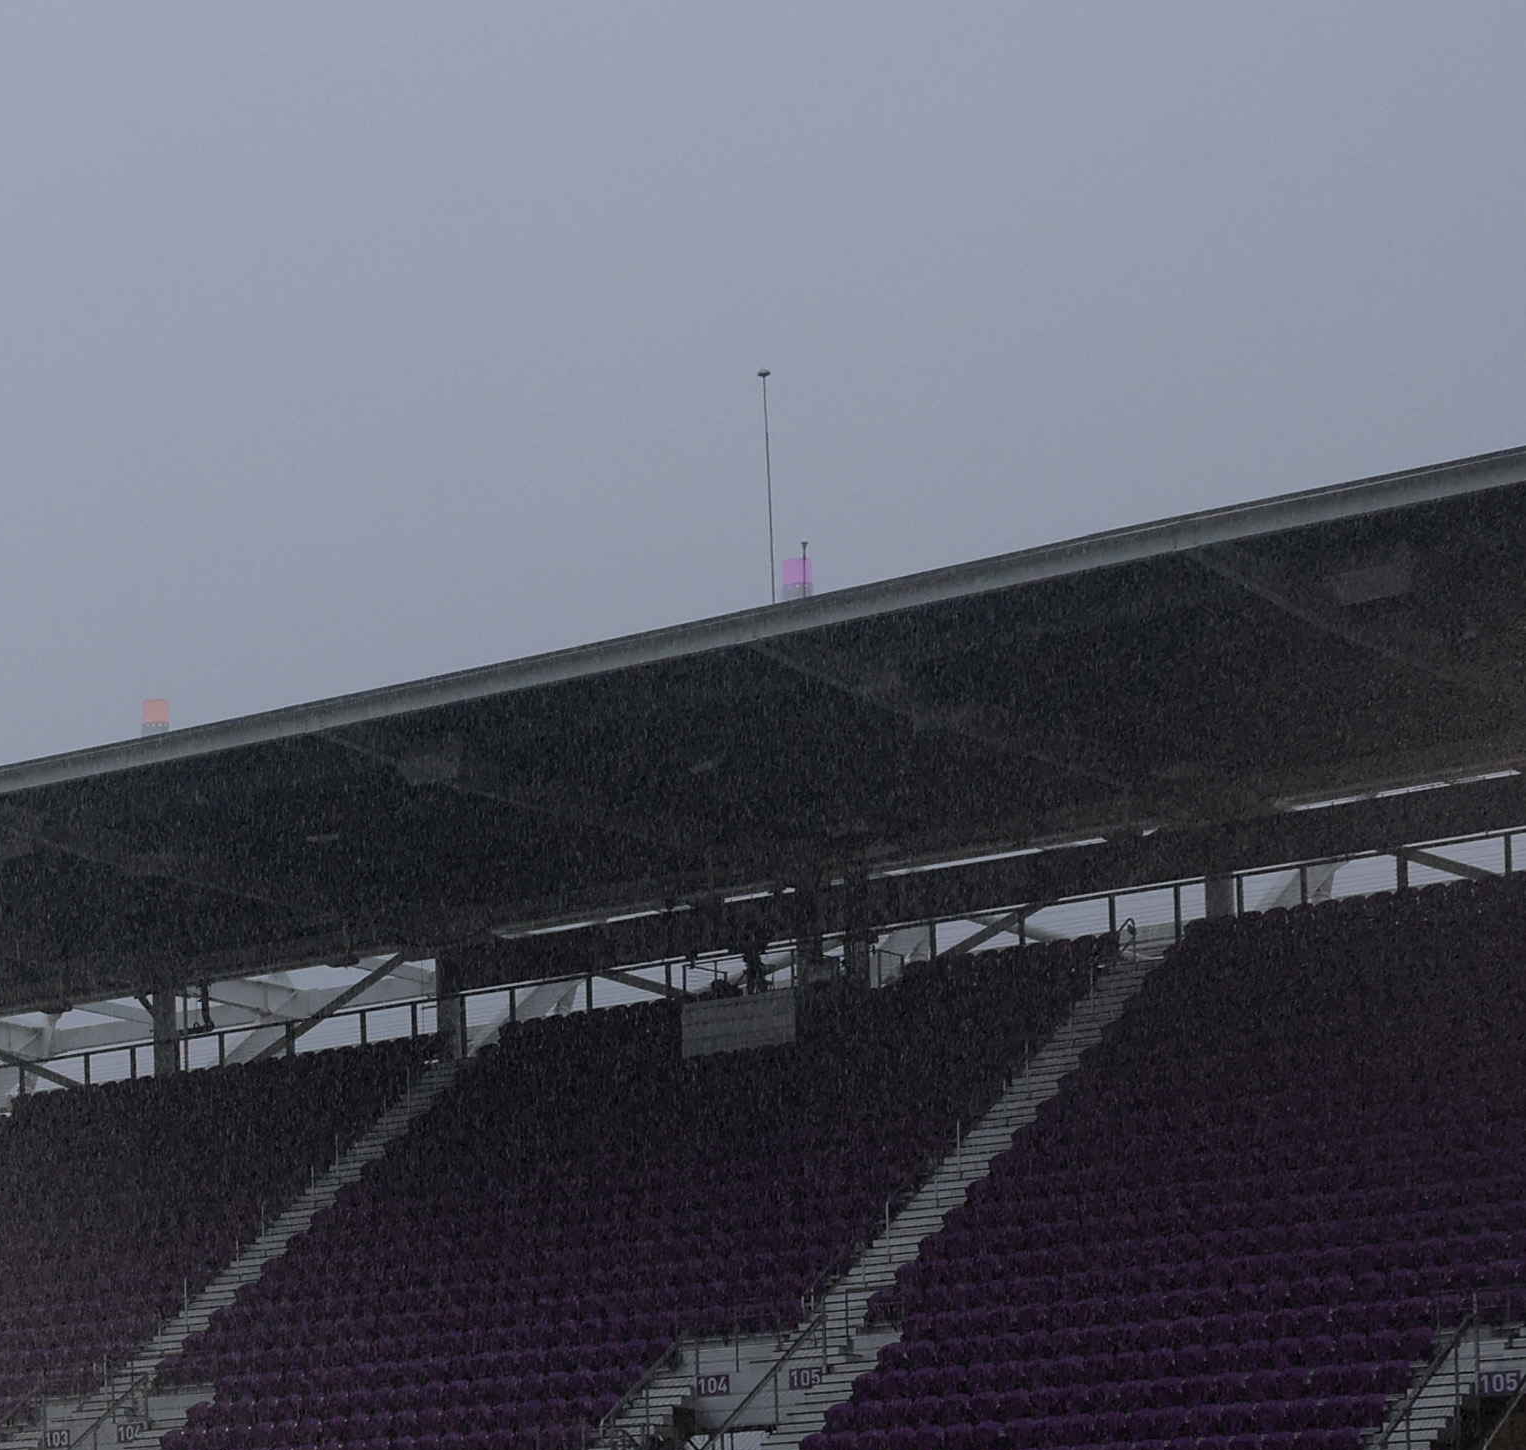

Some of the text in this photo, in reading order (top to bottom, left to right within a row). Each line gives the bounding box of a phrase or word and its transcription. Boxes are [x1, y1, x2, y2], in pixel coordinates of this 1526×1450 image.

[697, 1376, 728, 1395] 104
[791, 1368, 821, 1387] 105
[1480, 1372, 1519, 1394] 105
[45, 1430, 69, 1447] 103
